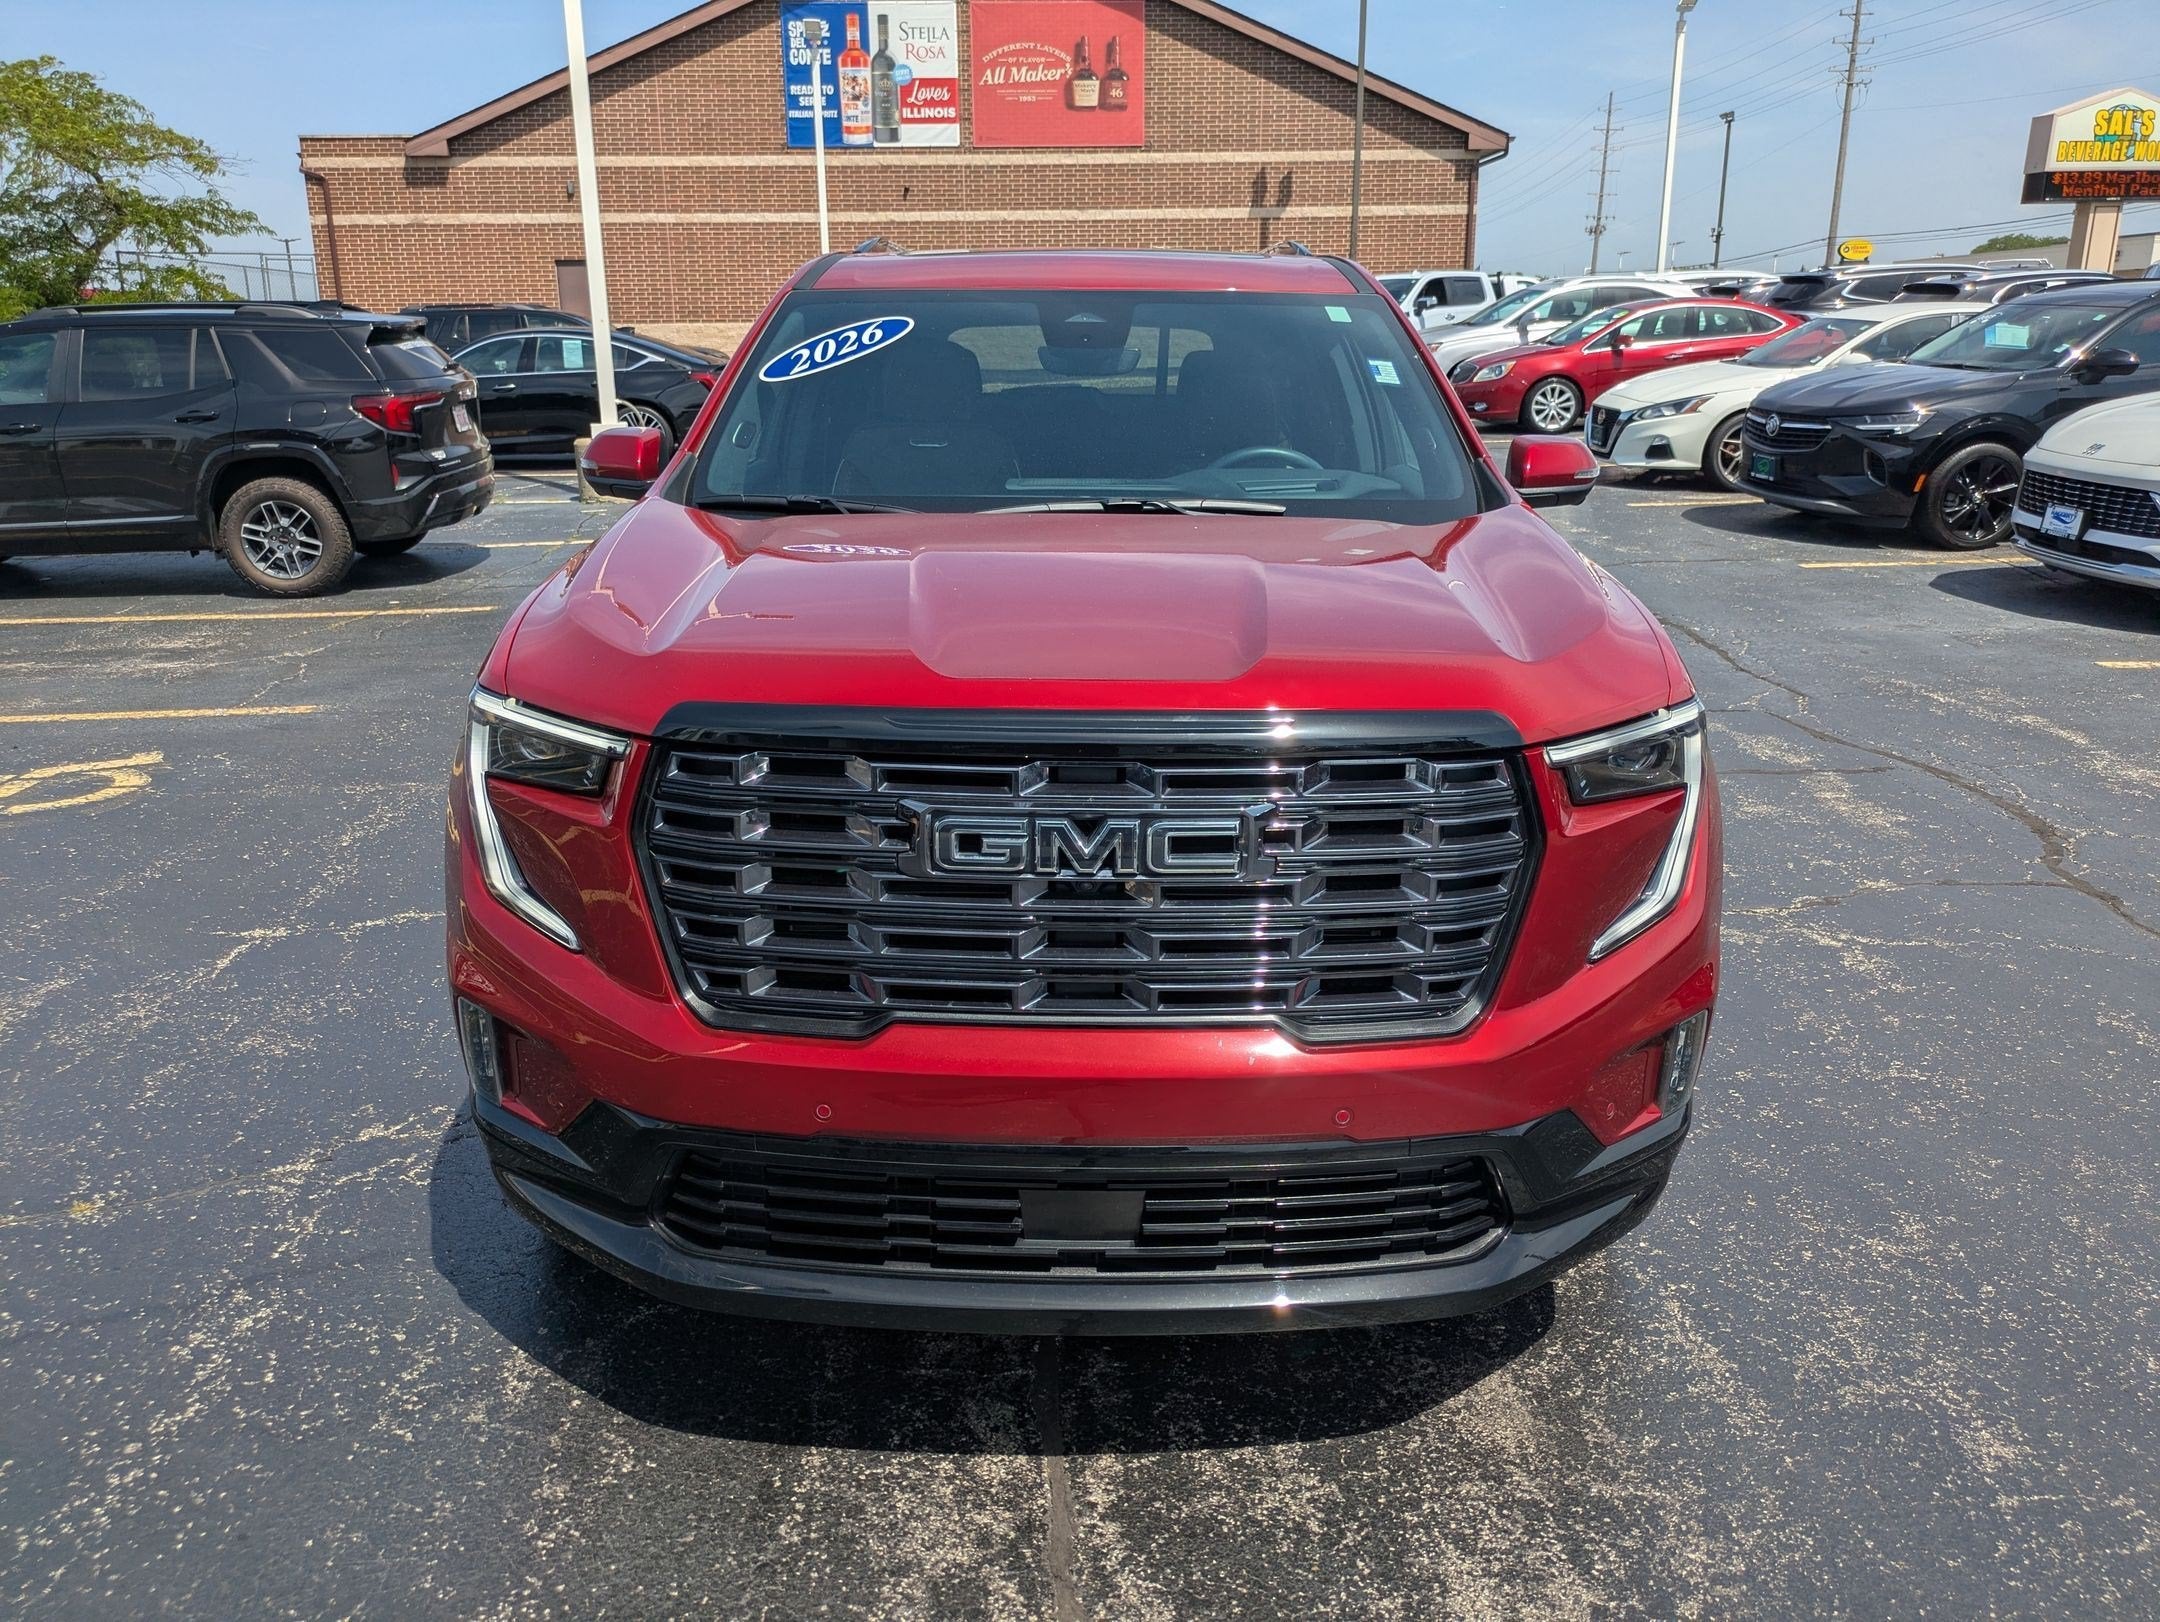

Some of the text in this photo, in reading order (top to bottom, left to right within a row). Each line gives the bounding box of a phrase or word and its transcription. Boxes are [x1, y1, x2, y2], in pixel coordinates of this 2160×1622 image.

[899, 21, 950, 43] STELLA
[790, 38, 807, 48] DEL
[905, 43, 946, 63] ROSA
[982, 42, 1072, 63] DIFFERENT LAYERS
[978, 62, 1073, 86] All Maker's
[790, 85, 834, 95] READ TO
[907, 80, 951, 105] Loves
[1109, 87, 1124, 98] 46
[902, 106, 956, 119] ILLINOIS
[2094, 109, 2156, 136] SAL'S
[2056, 141, 2130, 162] BEVERAGE
[2052, 171, 2103, 184] $13.89
[2062, 184, 2126, 197] Menthol
[789, 320, 884, 376] 2026
[934, 816, 1241, 874] GMC
